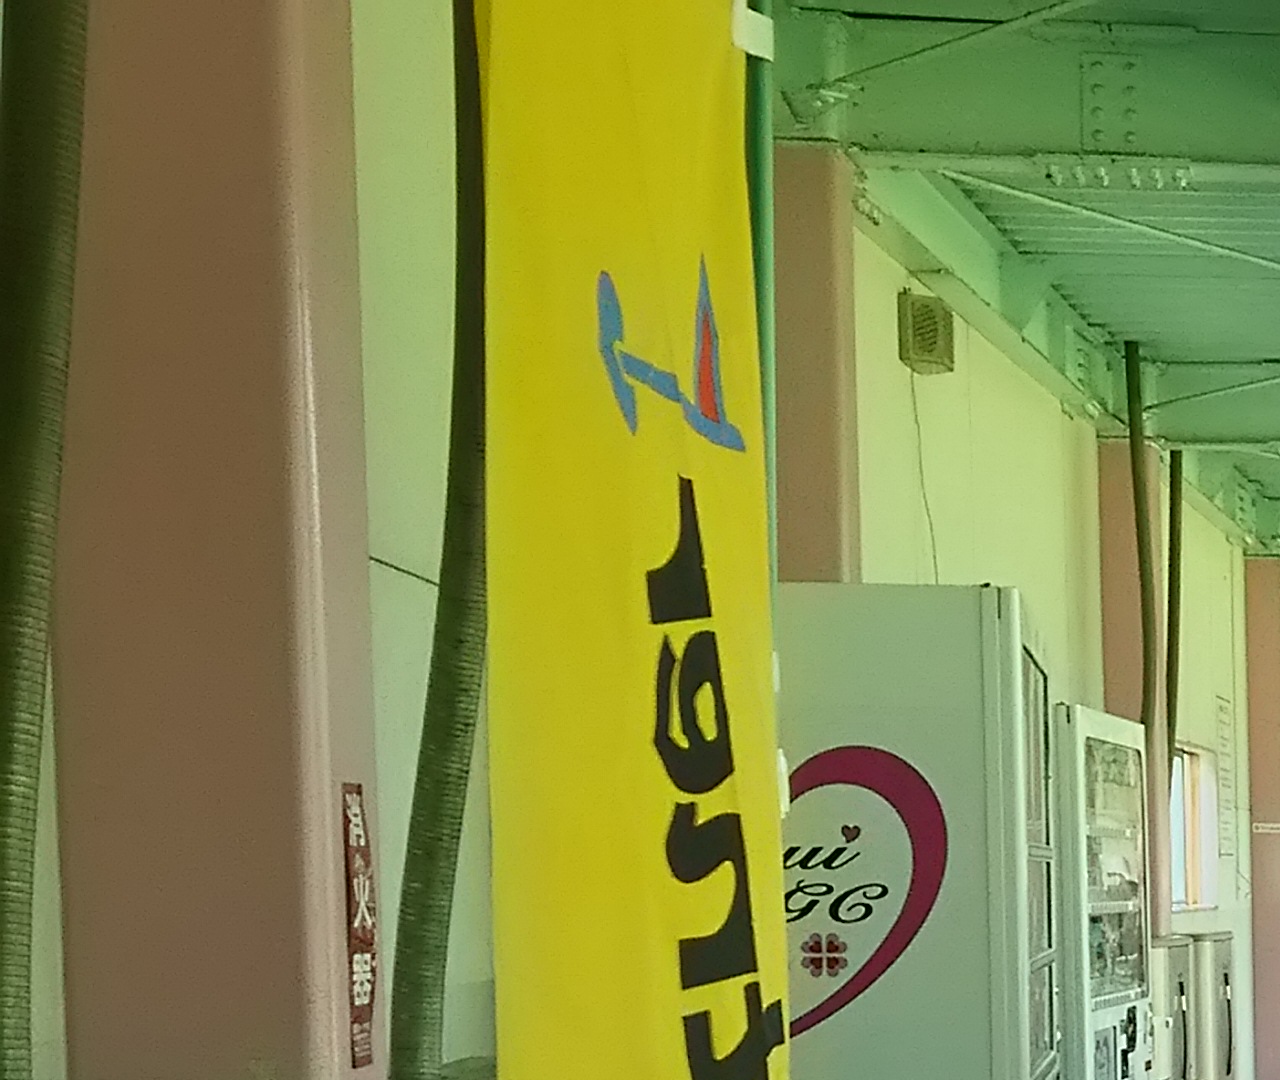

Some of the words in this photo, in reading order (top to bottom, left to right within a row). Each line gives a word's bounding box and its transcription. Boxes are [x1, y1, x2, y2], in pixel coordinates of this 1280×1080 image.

[784, 825, 860, 870] ui
[345, 793, 374, 1005] 消火器
[785, 879, 889, 923] GC
